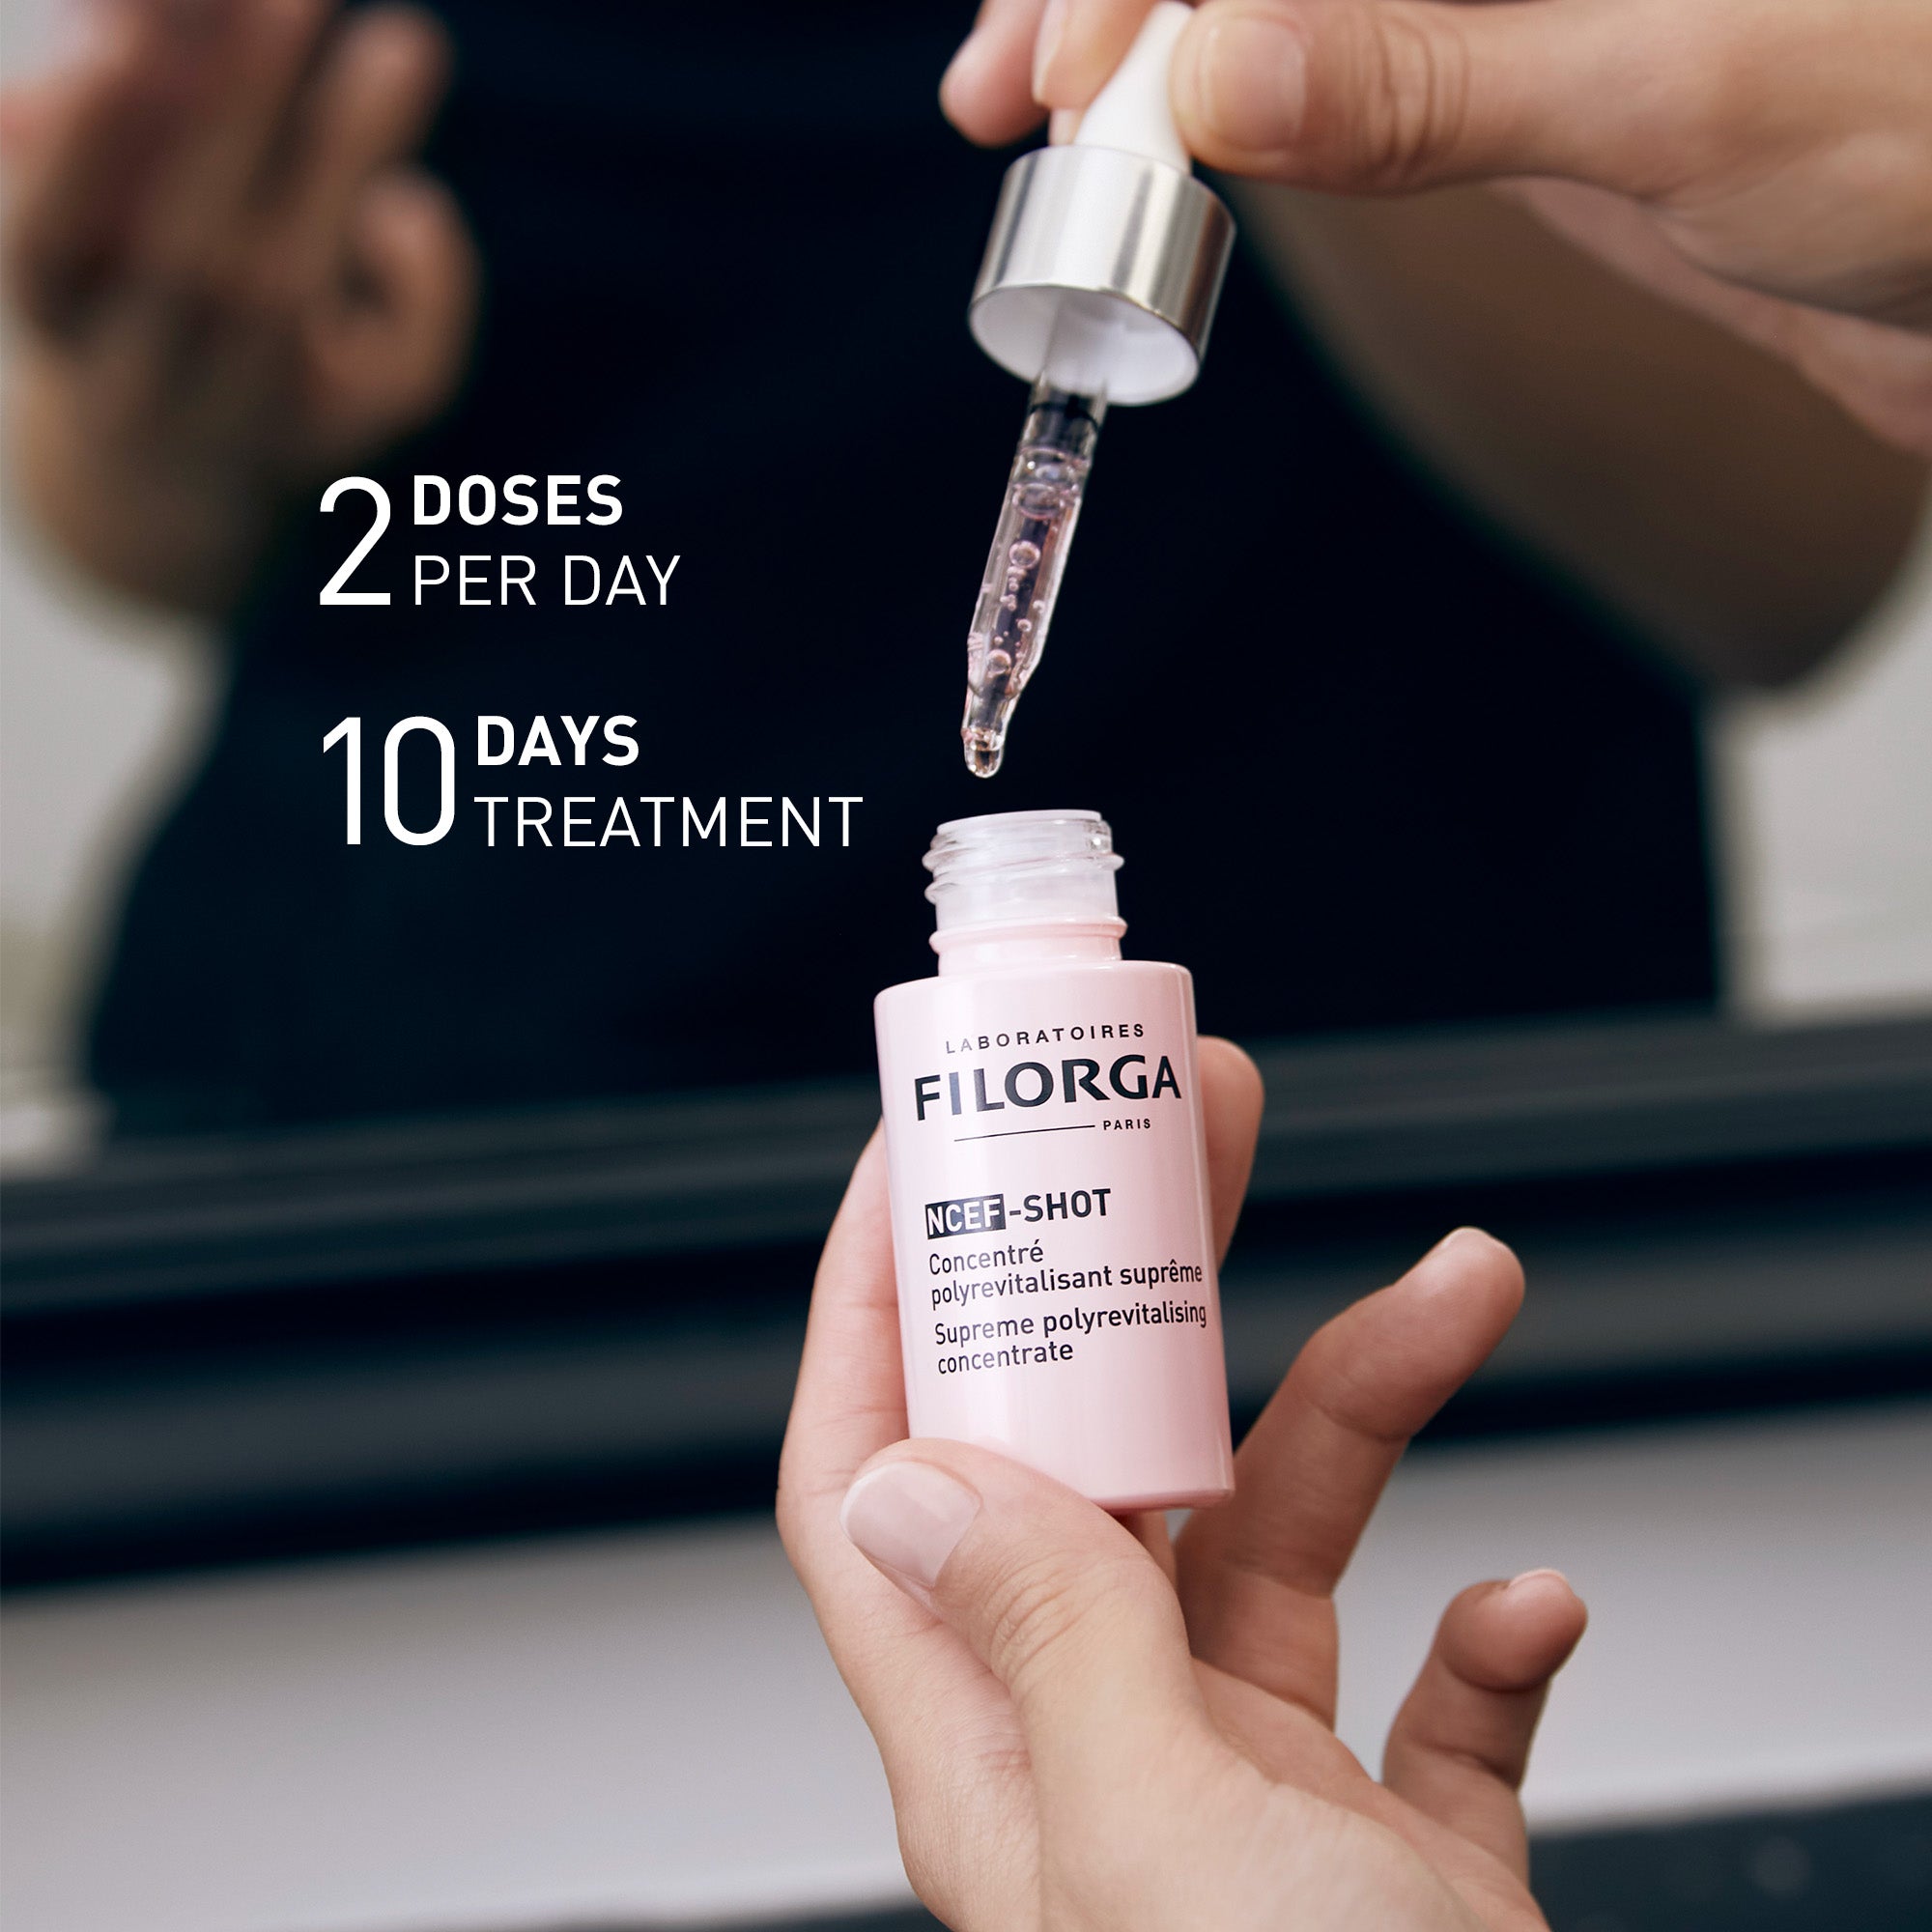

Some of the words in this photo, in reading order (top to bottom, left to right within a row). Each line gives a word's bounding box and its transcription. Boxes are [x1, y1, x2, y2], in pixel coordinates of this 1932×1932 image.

[946, 1023, 1145, 1054] LABORATOIRES
[914, 1053, 1182, 1122] FILORGA
[1102, 1118, 1151, 1131] PARIS
[924, 1187, 1112, 1240] NCEF-SHOT
[929, 1238, 1044, 1276] Concentré
[931, 1264, 1113, 1312] polyrevitalisant
[1120, 1258, 1204, 1291] suprême
[934, 1315, 1035, 1349] Supreme
[1042, 1299, 1208, 1339] polyrevitalising
[937, 1340, 1074, 1376] concentrate
